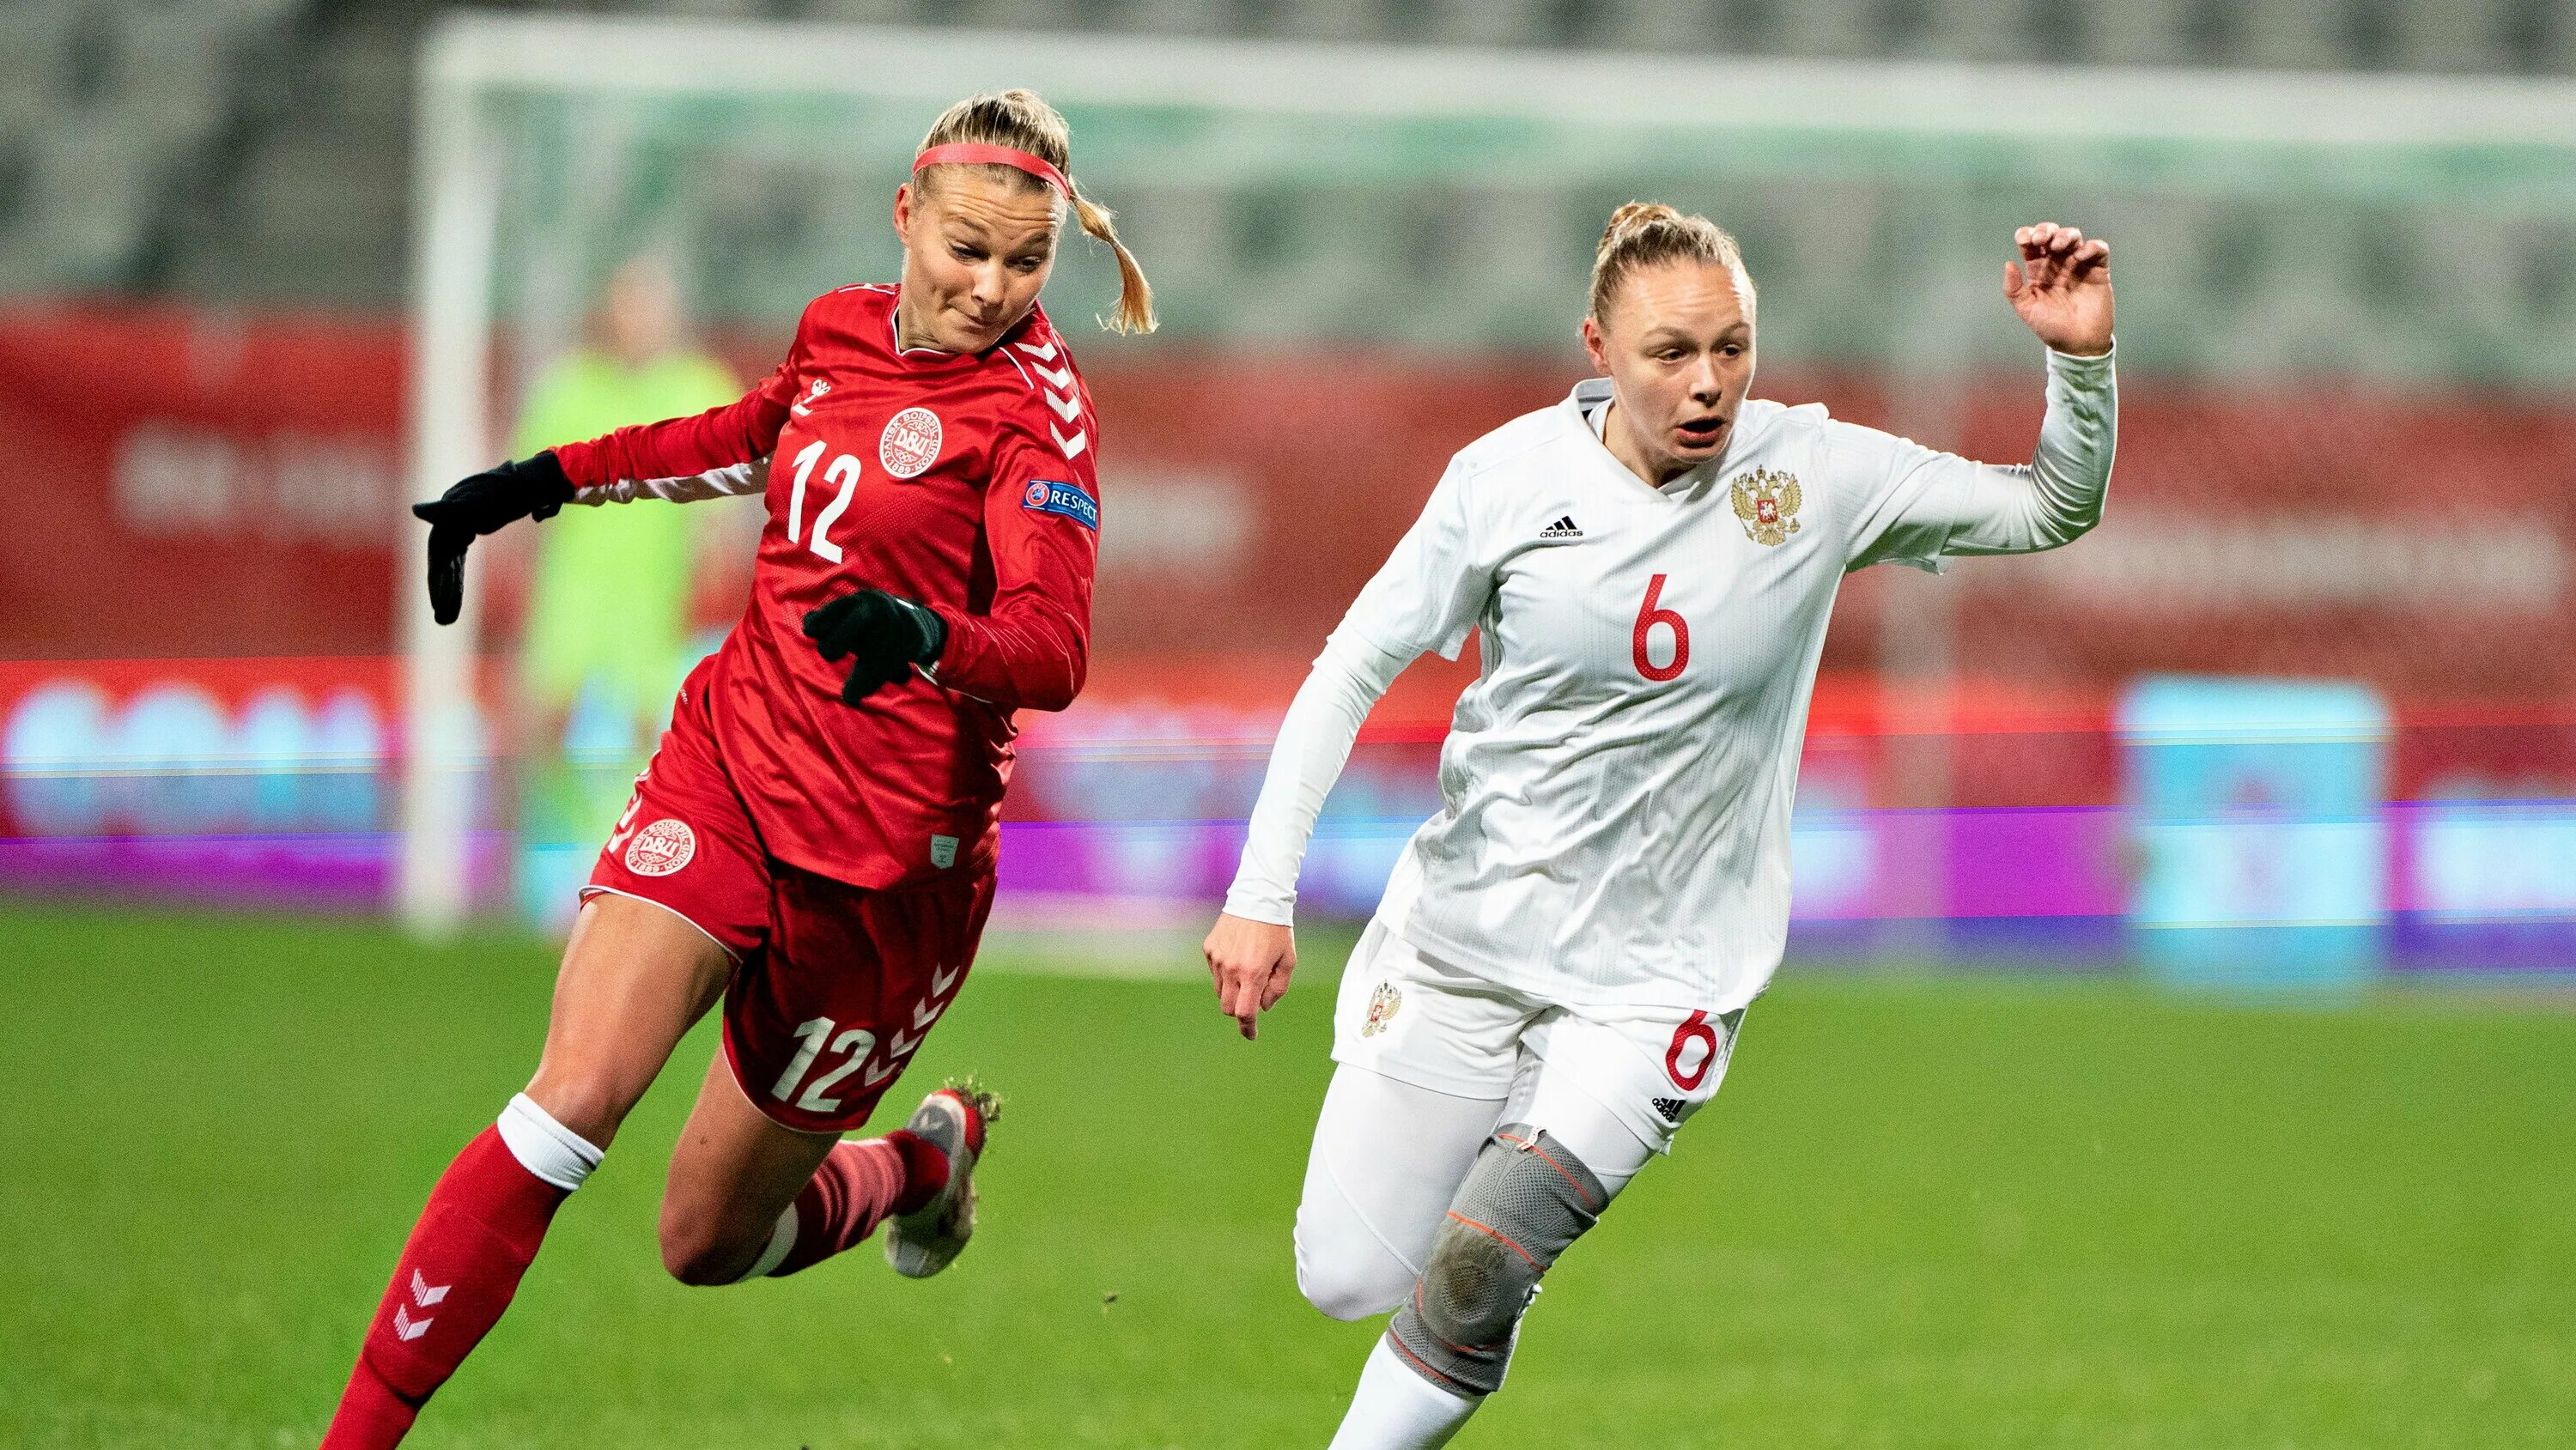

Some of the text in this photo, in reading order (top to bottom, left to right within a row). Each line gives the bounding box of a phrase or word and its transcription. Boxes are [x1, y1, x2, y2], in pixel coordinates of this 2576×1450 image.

[884, 419, 902, 458] DANSK
[914, 440, 939, 471] UNION
[894, 427, 930, 457] DBU
[888, 459, 911, 474] 1889
[787, 440, 862, 564] 12
[1050, 490, 1097, 522] RESPECT
[1540, 529, 1583, 538] adidas
[1632, 573, 1690, 682] 6
[639, 836, 680, 858] DBU
[771, 1016, 876, 1113] 12
[1665, 1009, 1717, 1092] 6
